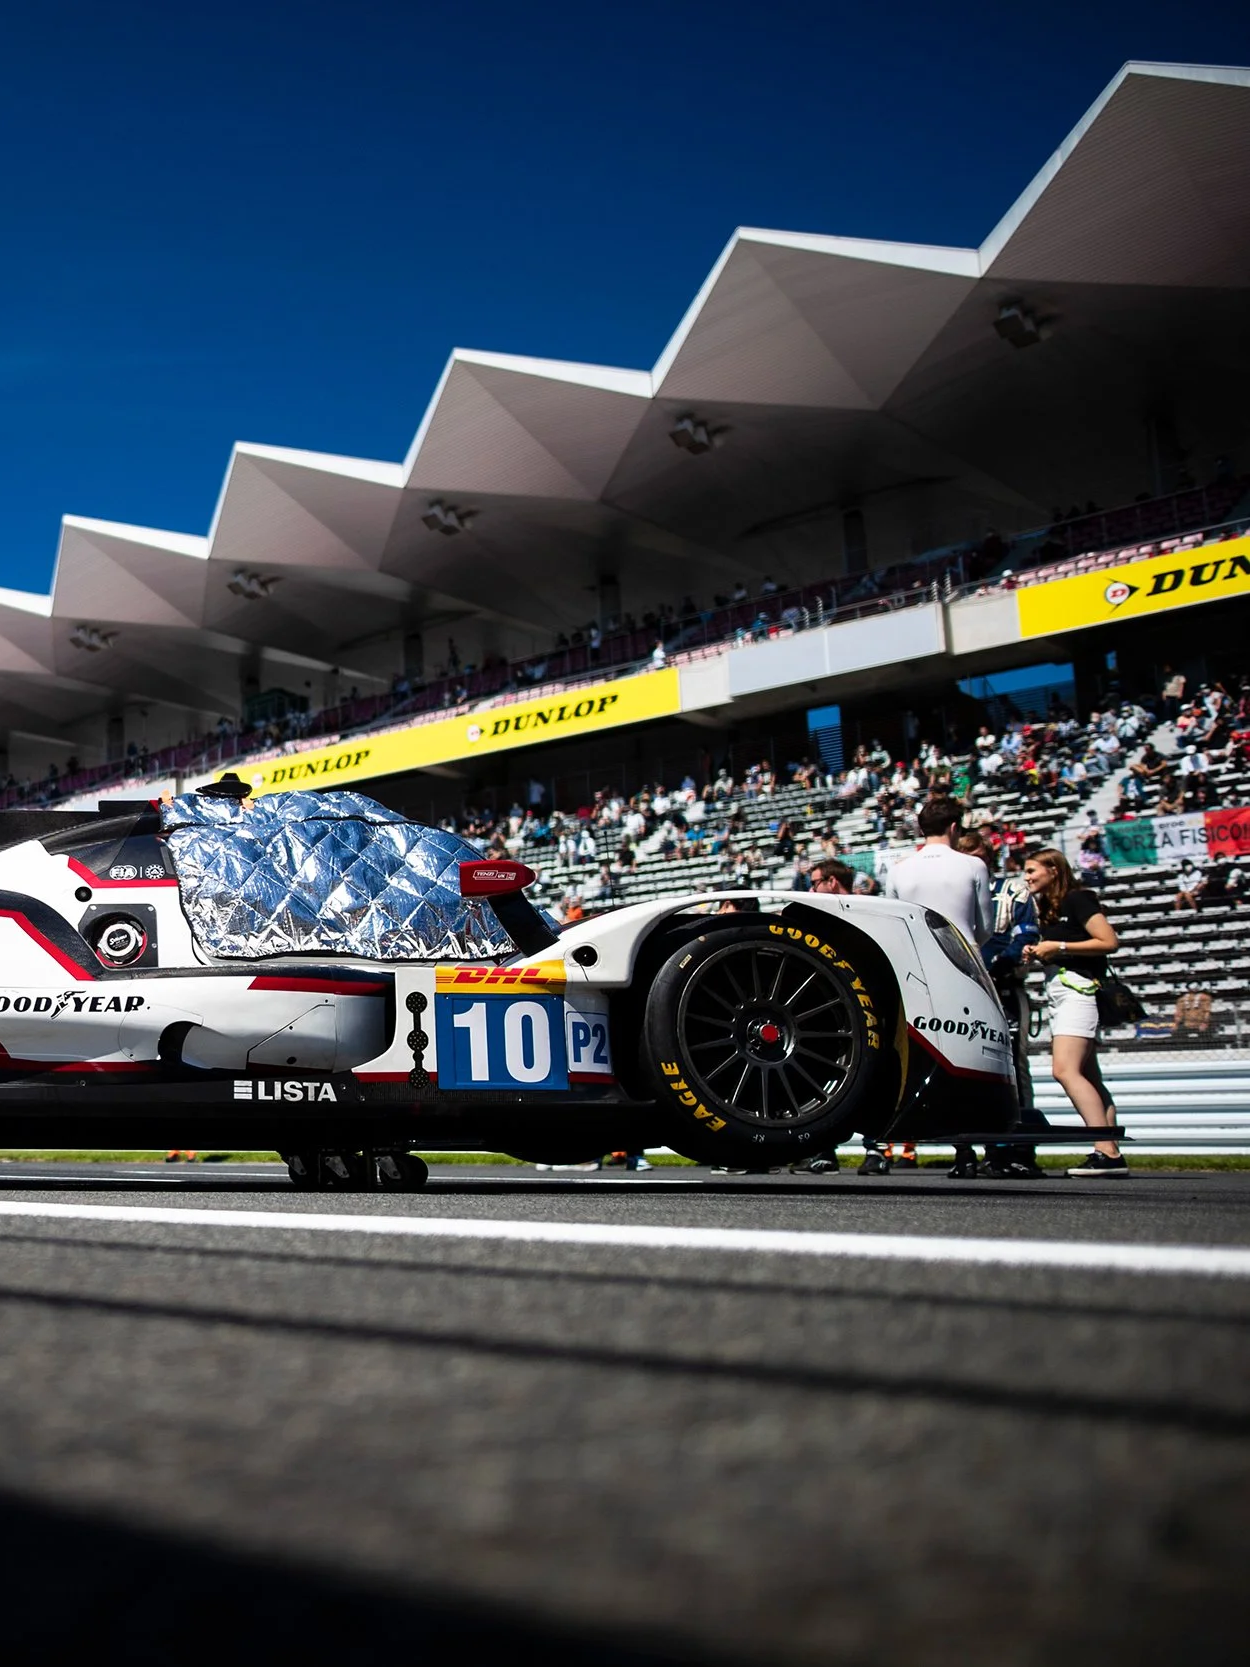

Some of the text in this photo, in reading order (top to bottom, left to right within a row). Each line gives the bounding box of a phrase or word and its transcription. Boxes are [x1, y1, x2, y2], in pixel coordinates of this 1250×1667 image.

[490, 694, 619, 737] DUNLOP
[270, 750, 371, 784] DUNLOP
[453, 967, 550, 984] DHL
[453, 1001, 552, 1083] 10
[571, 1021, 609, 1064] P2
[257, 1080, 338, 1102] LISTA
